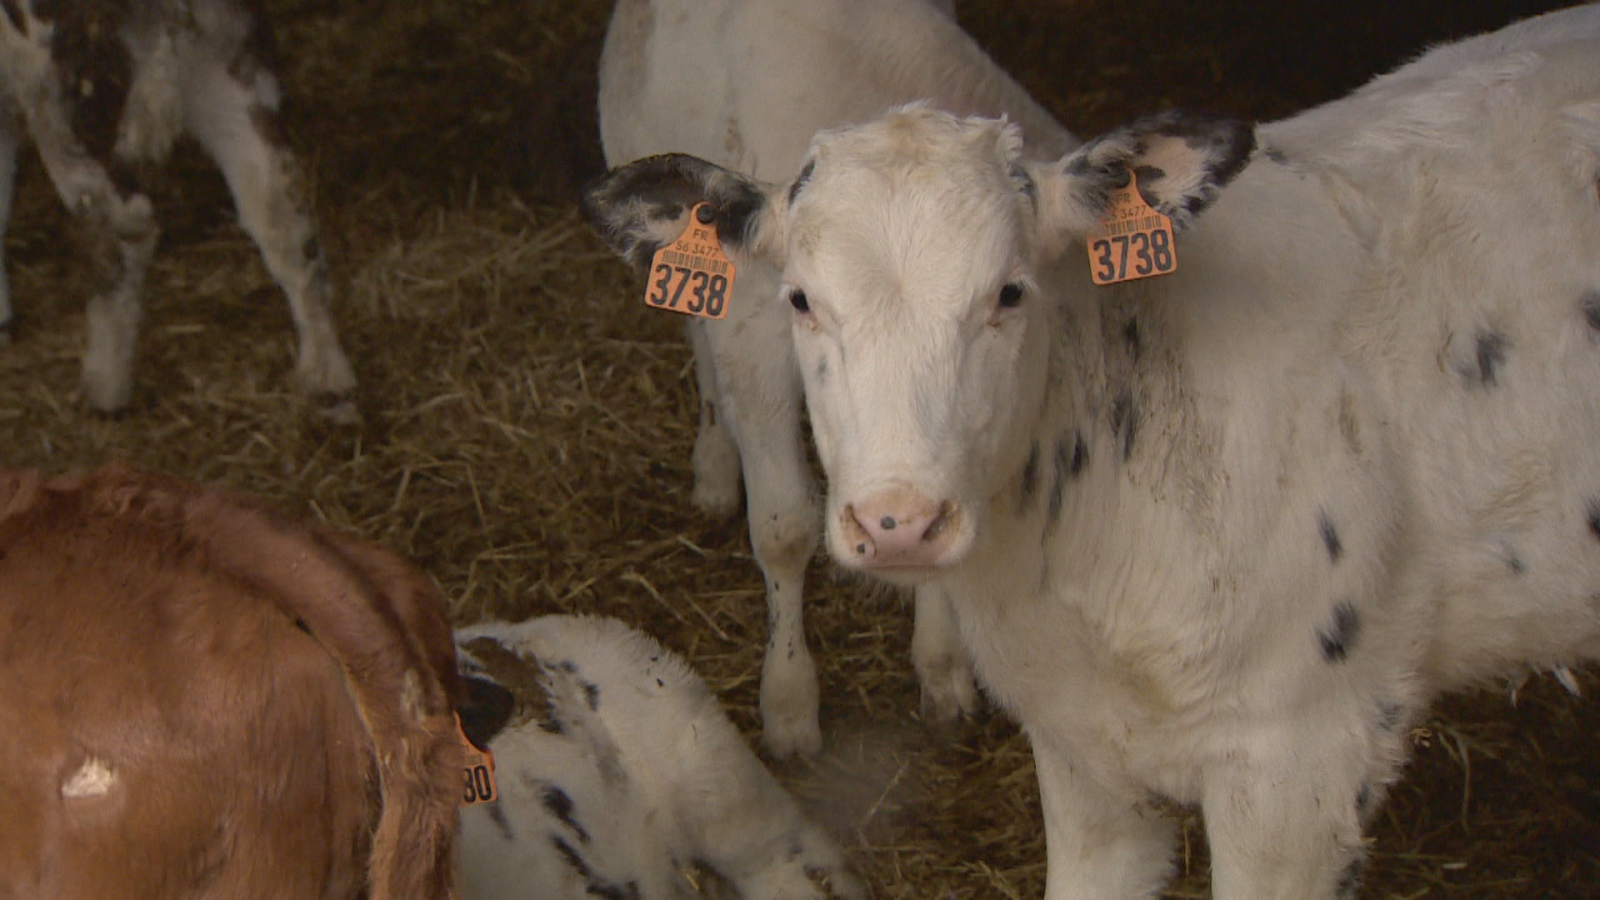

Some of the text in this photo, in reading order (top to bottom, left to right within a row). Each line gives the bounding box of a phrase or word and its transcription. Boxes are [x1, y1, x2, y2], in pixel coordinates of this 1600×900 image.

[675, 240, 720, 258] 56 3477
[693, 228, 709, 241] FR
[1093, 229, 1172, 282] 3738
[650, 263, 728, 317] 3738
